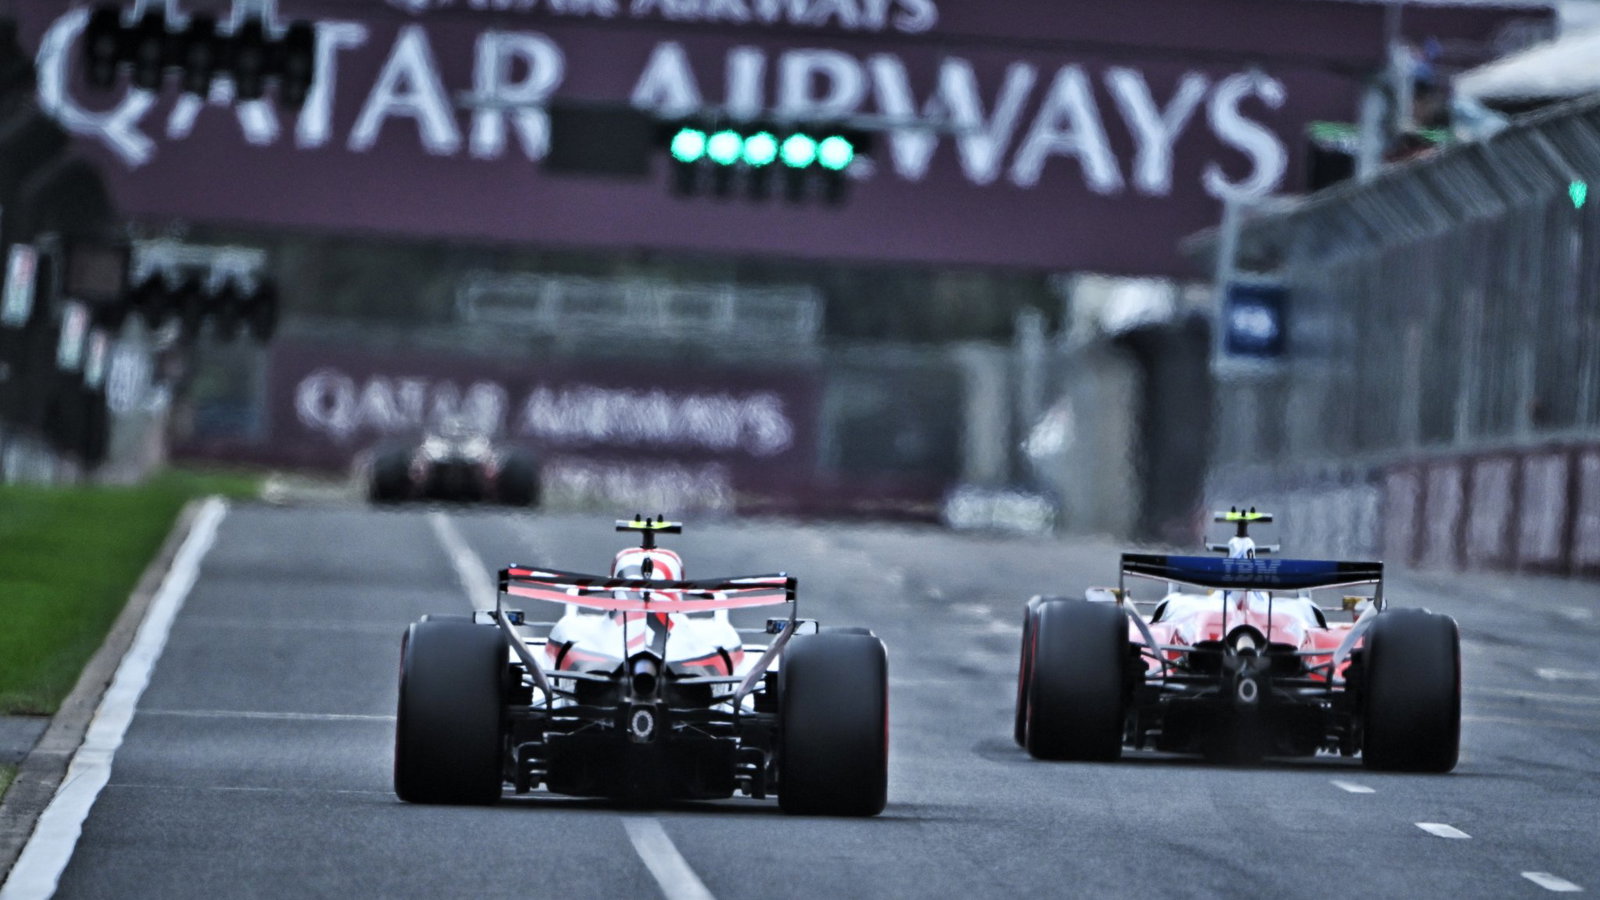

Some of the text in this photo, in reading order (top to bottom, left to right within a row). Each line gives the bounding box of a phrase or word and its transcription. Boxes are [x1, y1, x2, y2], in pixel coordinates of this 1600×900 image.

[36, 6, 1288, 201] QTAR AIRWAYS
[1222, 558, 1281, 583] IBM
